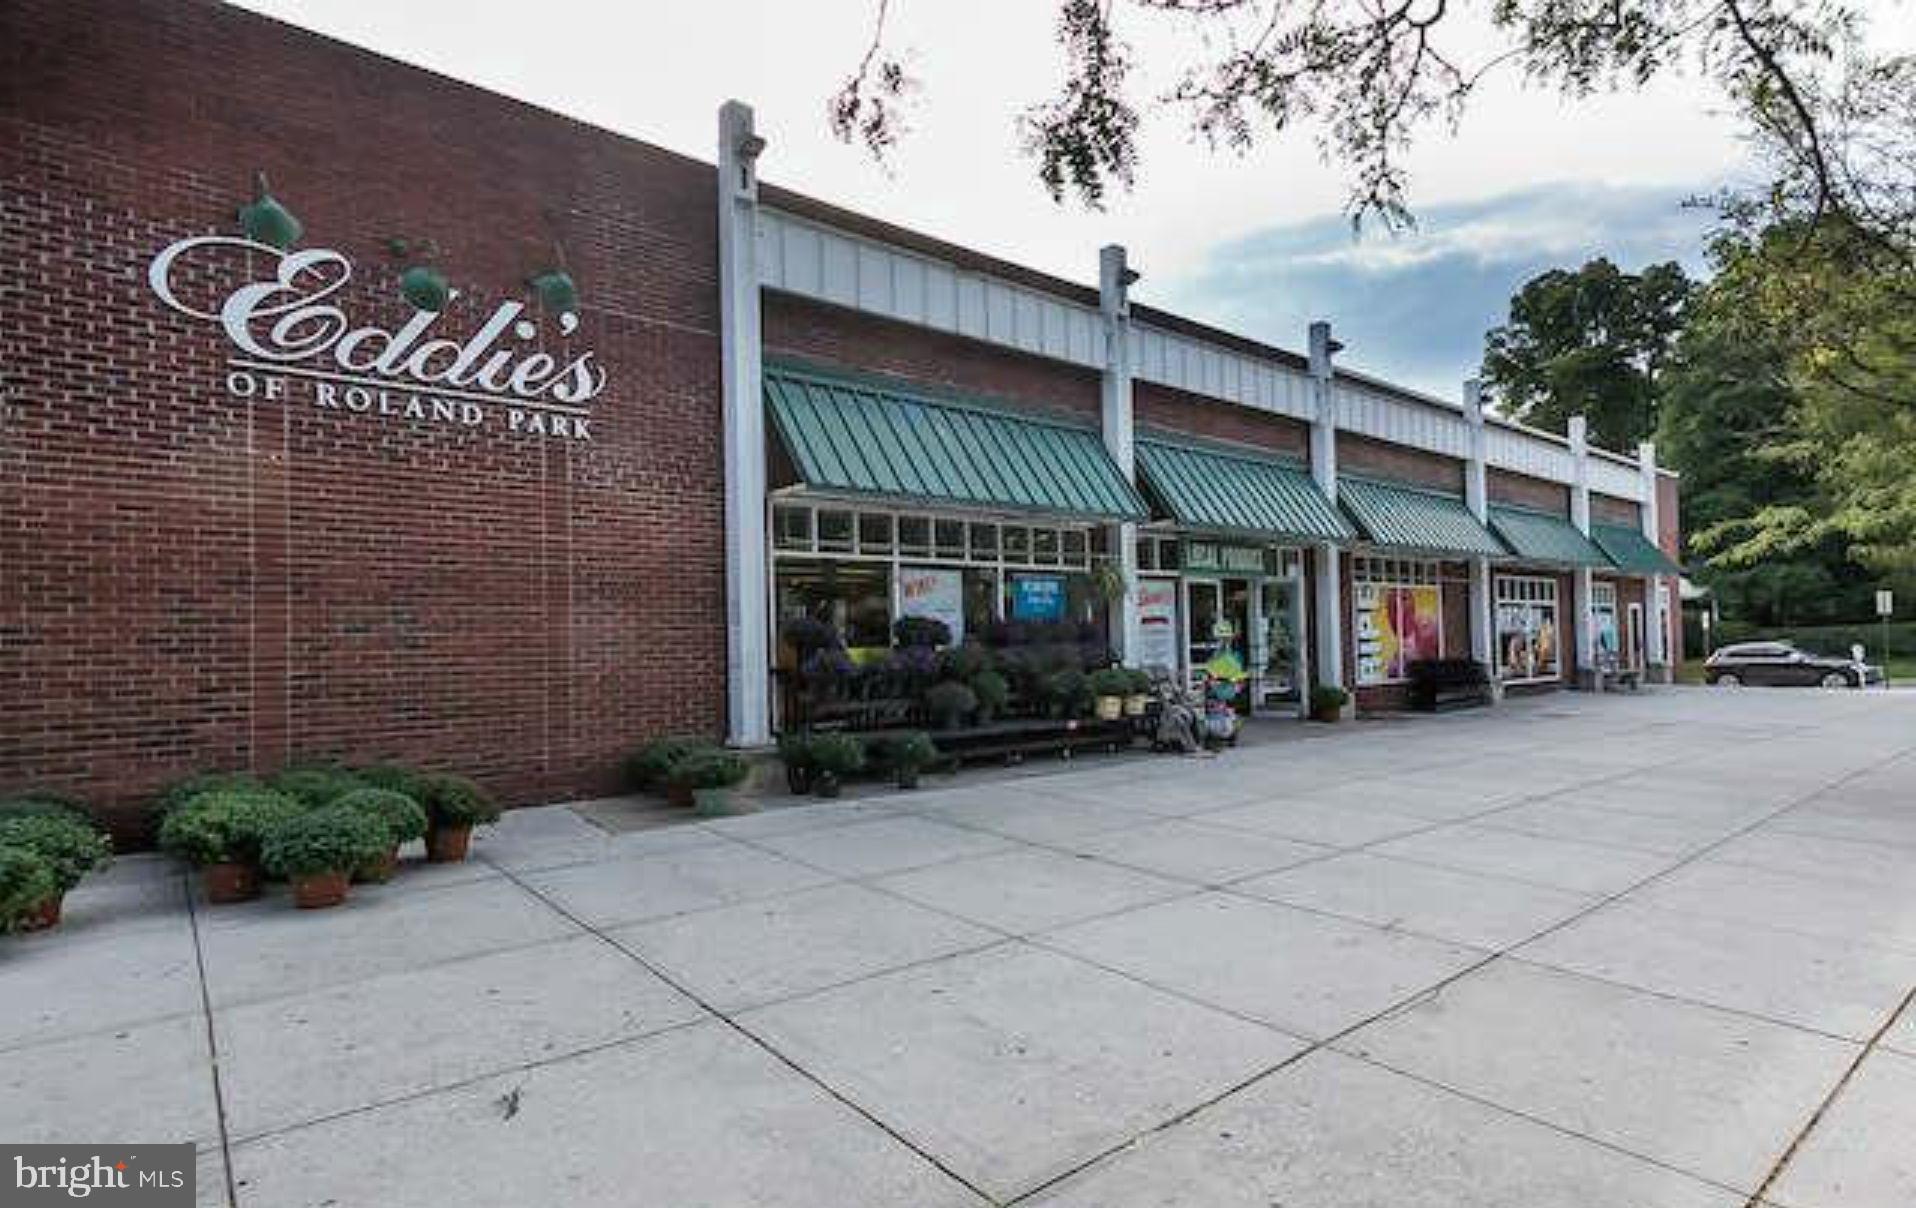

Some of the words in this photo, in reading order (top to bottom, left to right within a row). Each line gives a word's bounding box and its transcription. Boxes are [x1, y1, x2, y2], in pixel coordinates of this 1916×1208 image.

[149, 236, 606, 402] Eddie's
[226, 371, 285, 400] OF
[315, 383, 483, 426] ROLAND
[508, 408, 592, 440] PARK
